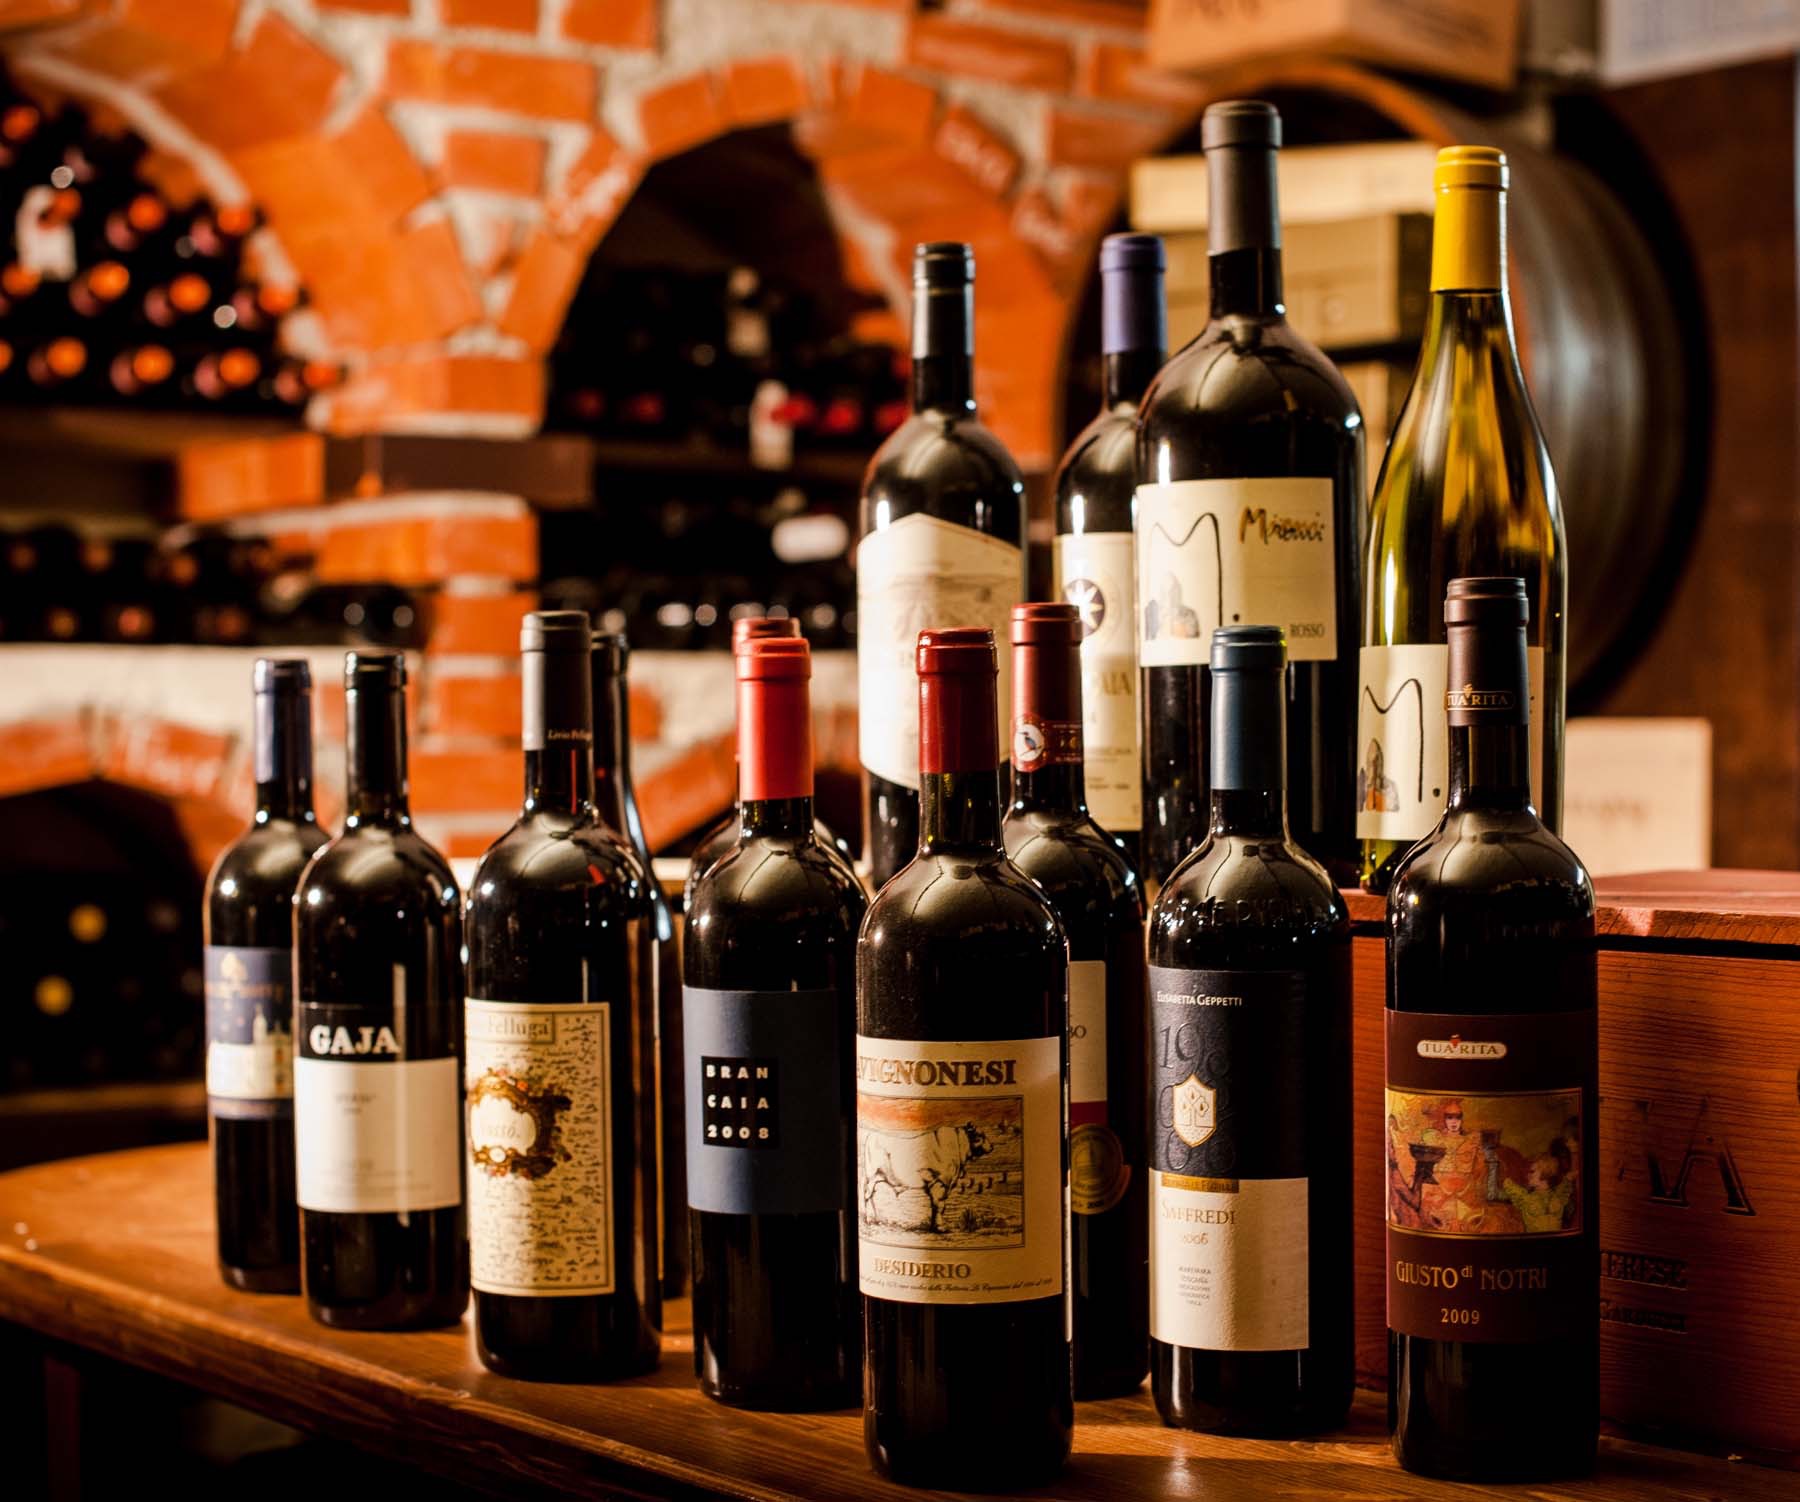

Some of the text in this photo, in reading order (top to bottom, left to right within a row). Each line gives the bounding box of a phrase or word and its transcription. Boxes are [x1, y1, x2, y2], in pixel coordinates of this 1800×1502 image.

[1289, 623, 1325, 638] ROSSO
[1471, 693, 1509, 706] RITA
[1196, 993, 1243, 1007] GEPPETTI
[309, 1024, 401, 1055] GAJA
[1422, 1042, 1500, 1056] TUA RITA
[705, 1063, 769, 1079] BRAN
[706, 1093, 769, 1110] CAIA
[707, 1123, 770, 1140] 2008
[873, 1256, 971, 1279] DESIDERIO
[1395, 1260, 1548, 1291] GIUSTO di NOTRI
[1440, 1307, 1481, 1325] 2009
